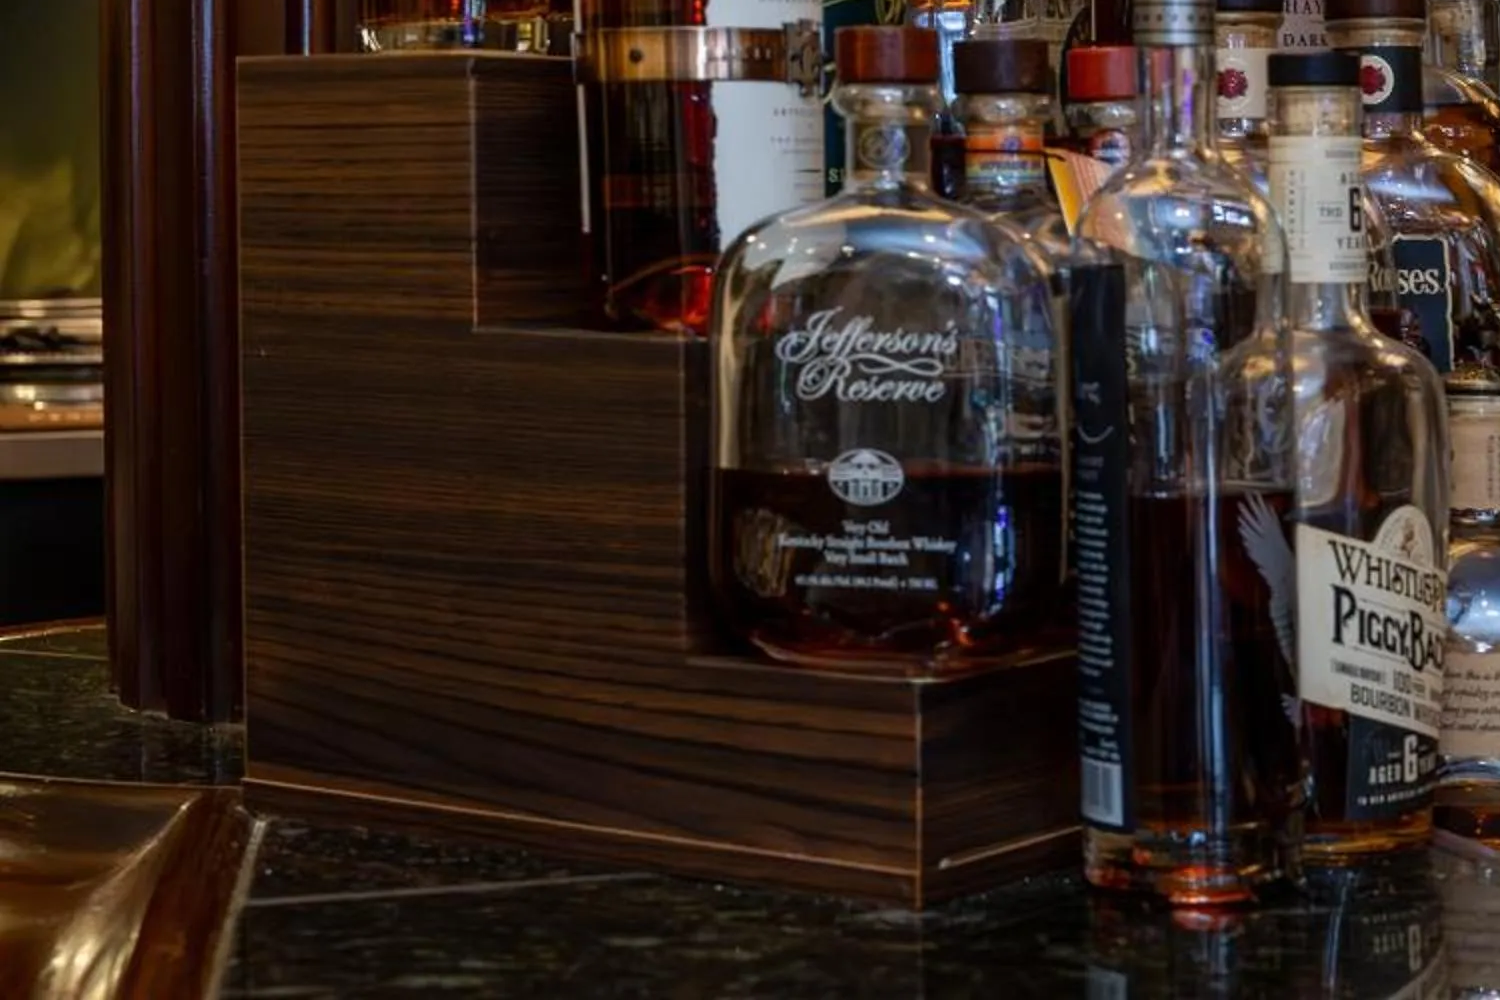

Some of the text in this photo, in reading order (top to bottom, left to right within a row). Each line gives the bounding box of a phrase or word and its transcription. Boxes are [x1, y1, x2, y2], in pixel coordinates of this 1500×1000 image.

[775, 305, 959, 362] Jefferson's
[797, 357, 946, 402] Reserve
[1404, 734, 1418, 773] 6
